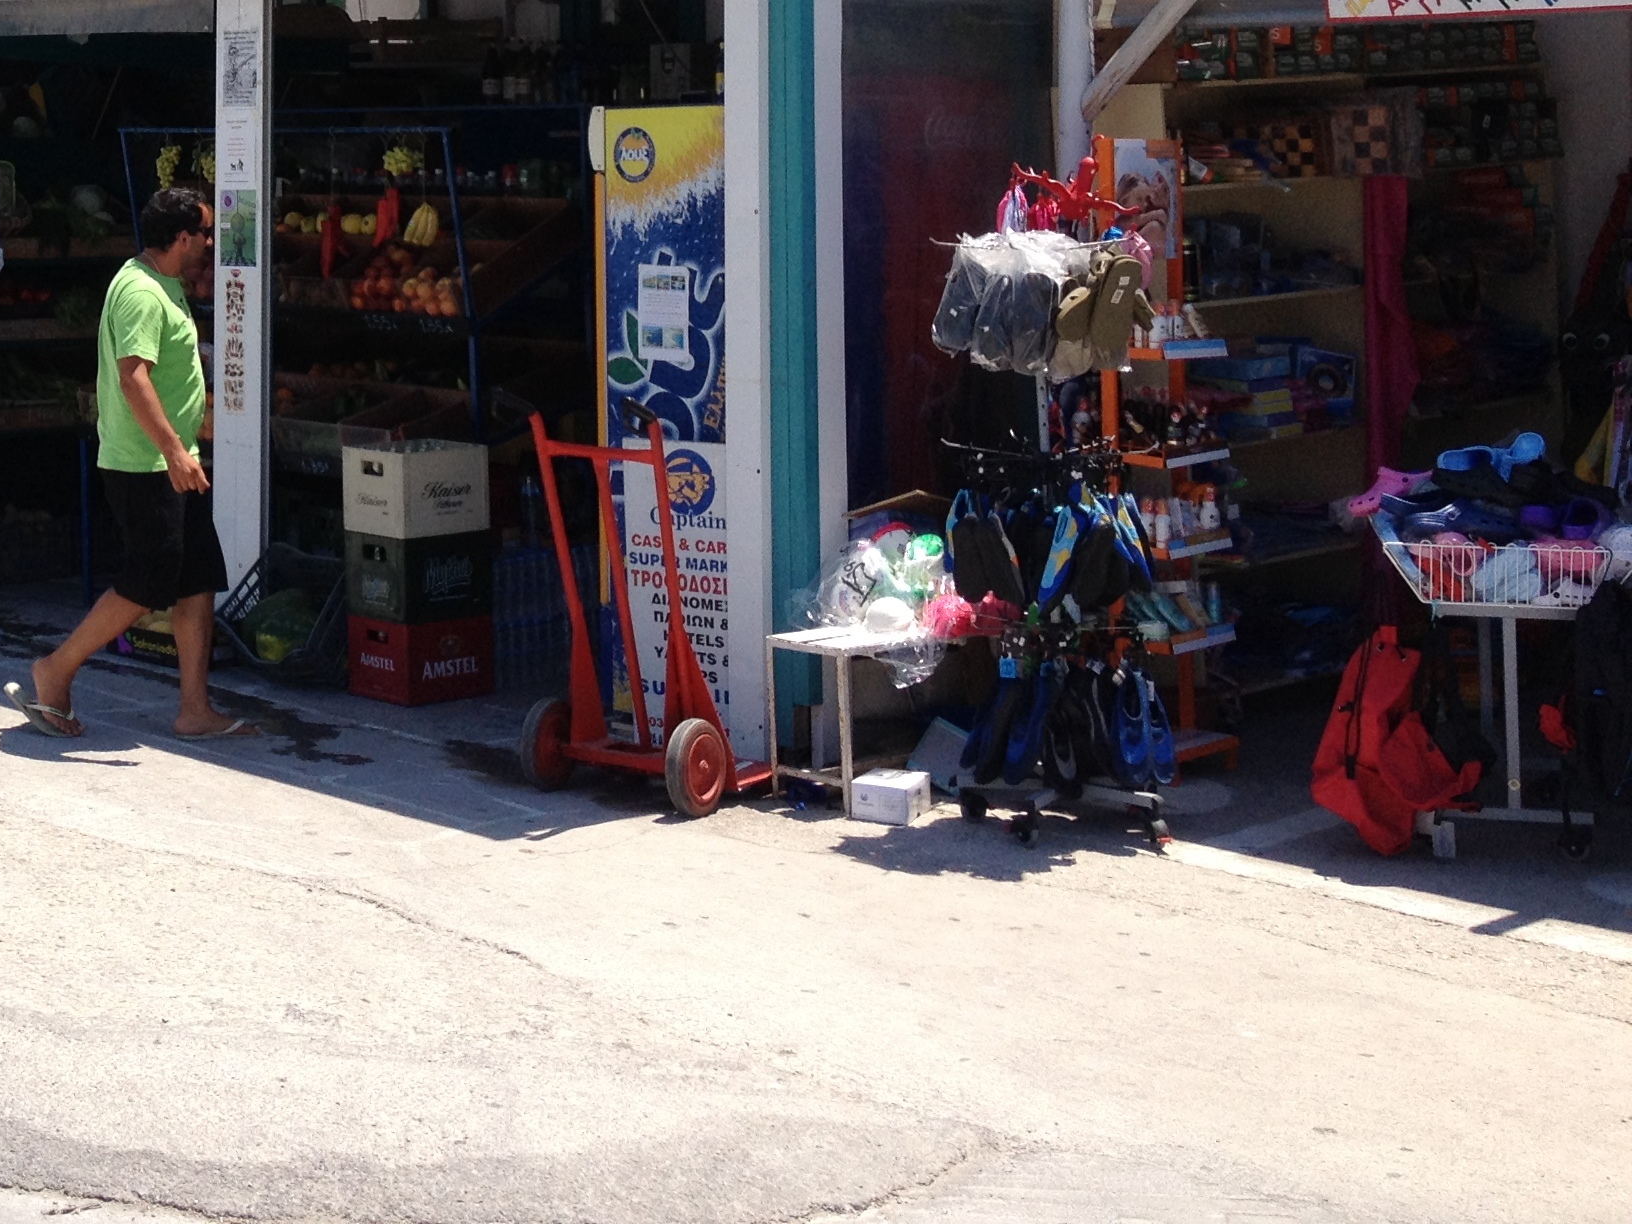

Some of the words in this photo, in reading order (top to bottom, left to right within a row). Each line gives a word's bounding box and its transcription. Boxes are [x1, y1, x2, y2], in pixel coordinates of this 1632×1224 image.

[650, 506, 727, 531] Cptain
[679, 538, 690, 551] &
[360, 652, 396, 672] AMSTEL
[422, 656, 479, 680] AMSTEL
